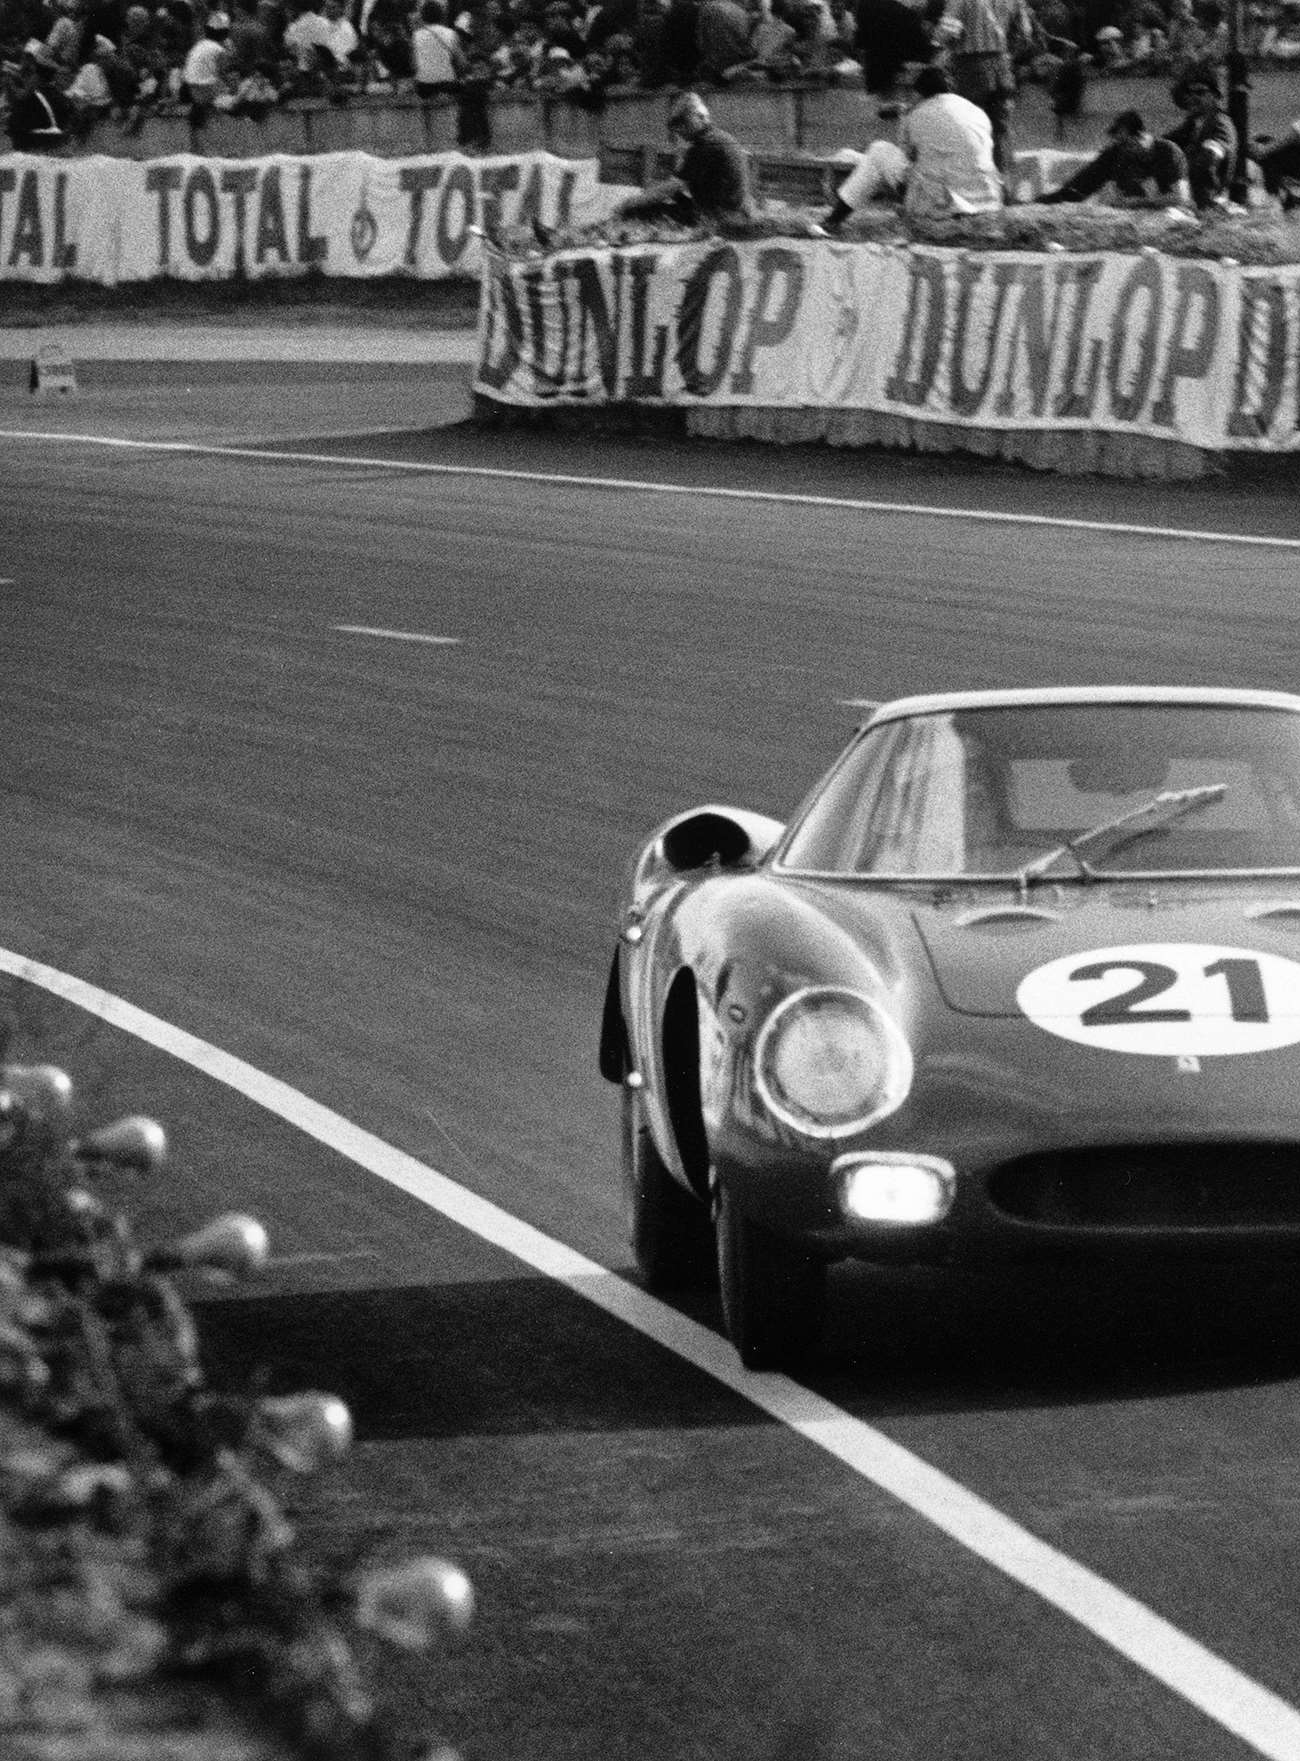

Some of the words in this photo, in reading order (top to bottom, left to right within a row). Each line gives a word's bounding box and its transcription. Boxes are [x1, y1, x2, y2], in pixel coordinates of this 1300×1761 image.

[146, 164, 328, 278] TOTAL
[884, 250, 1222, 427] DUNLOP
[1068, 957, 1270, 1027] 21
